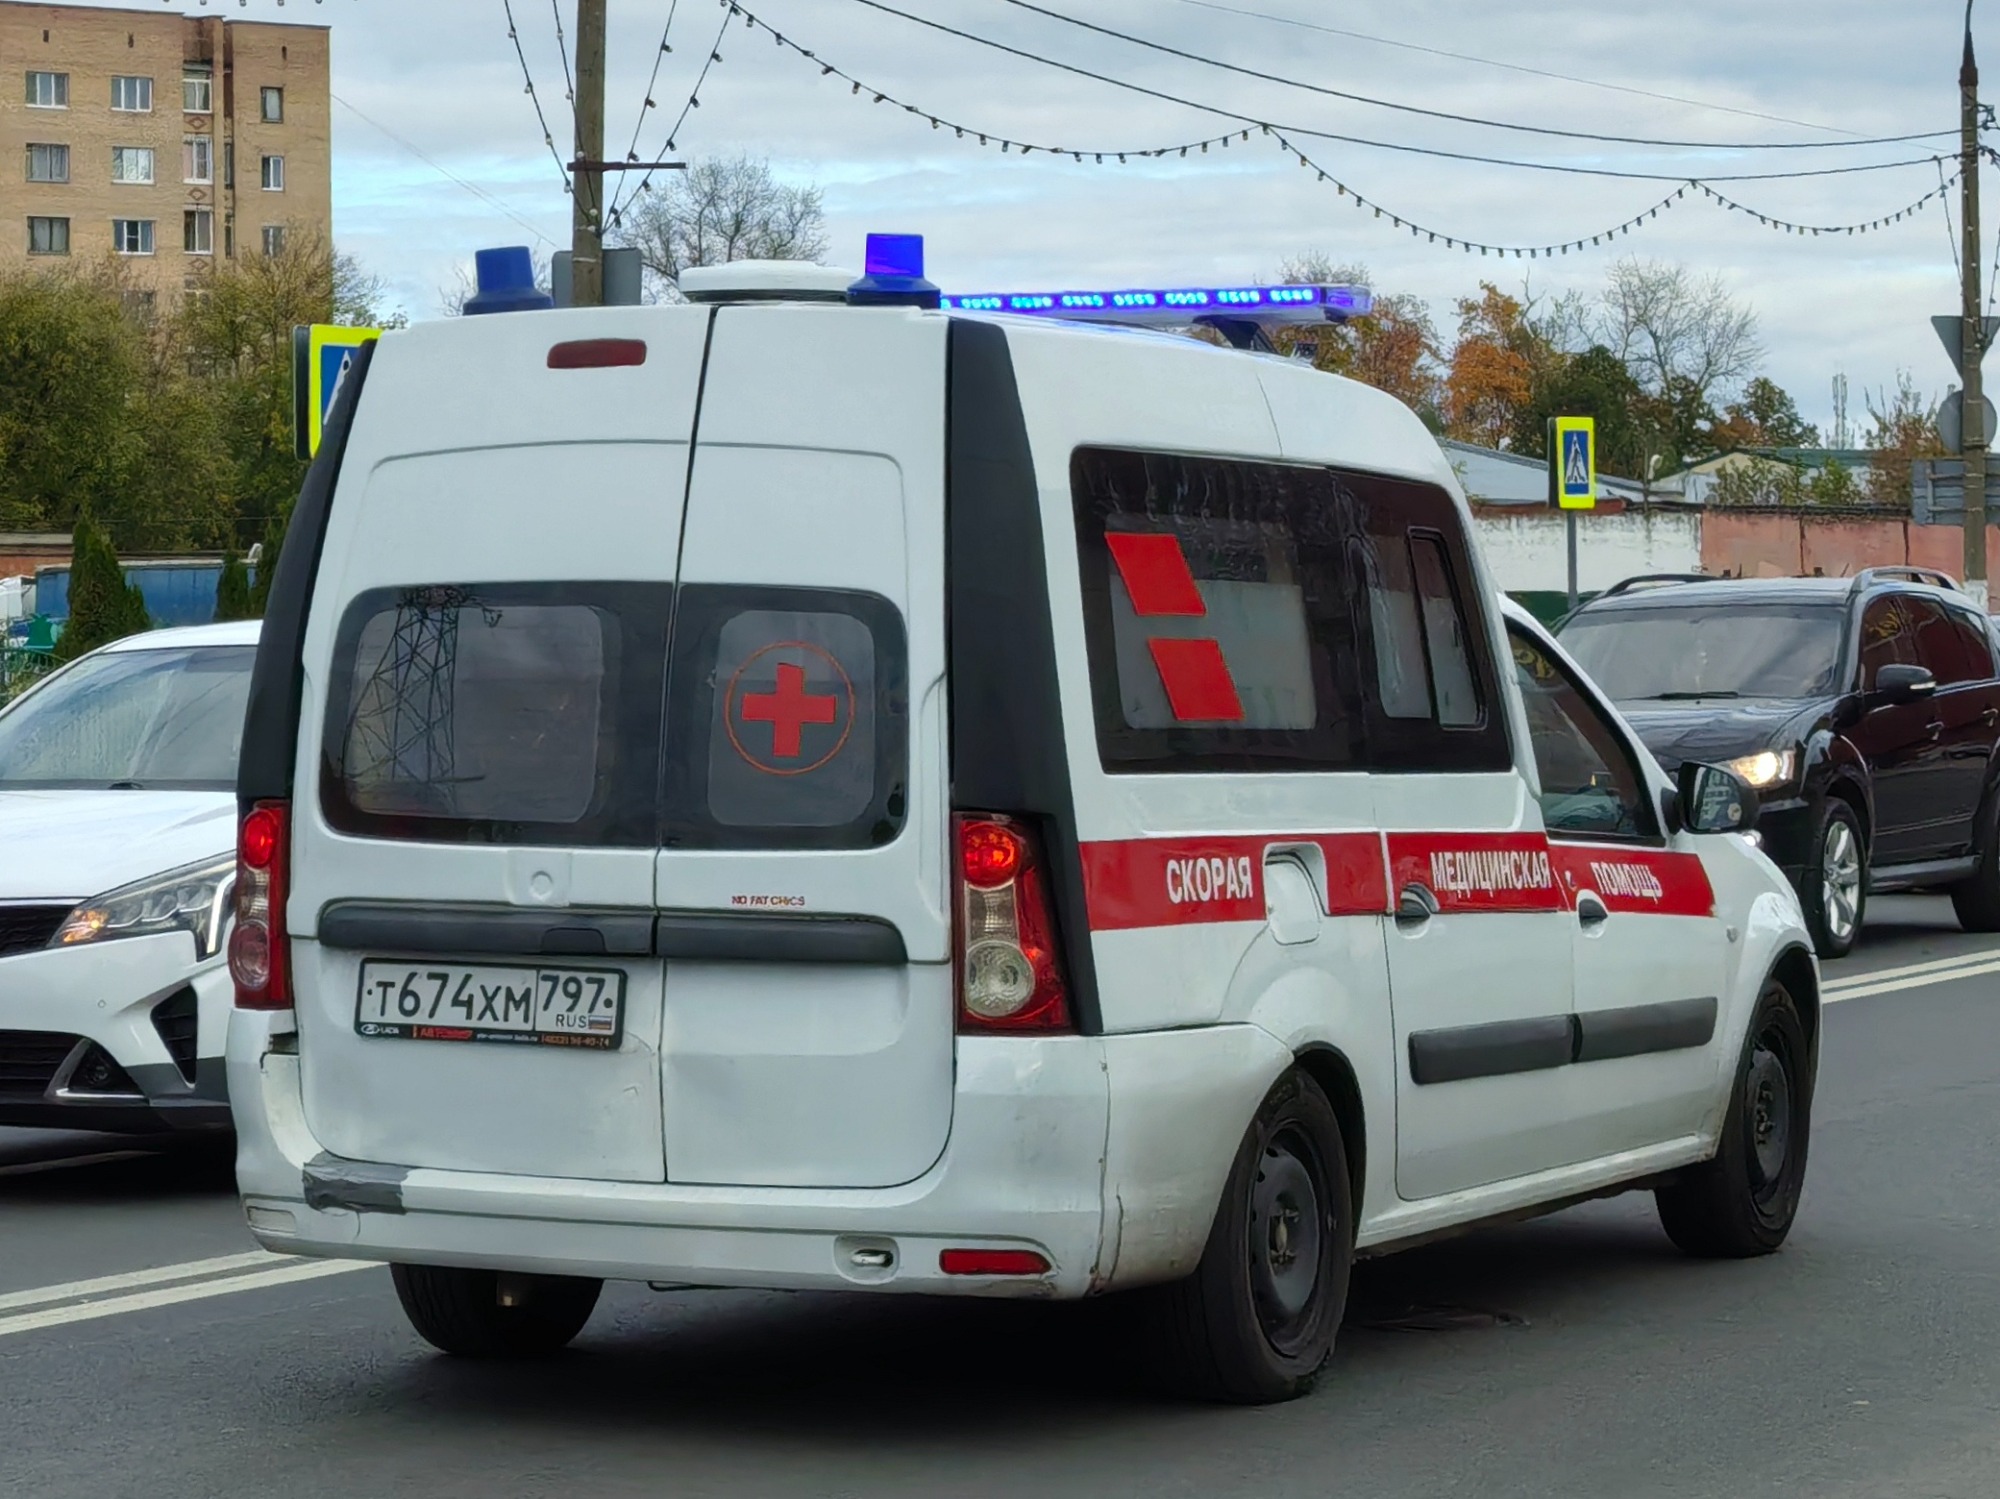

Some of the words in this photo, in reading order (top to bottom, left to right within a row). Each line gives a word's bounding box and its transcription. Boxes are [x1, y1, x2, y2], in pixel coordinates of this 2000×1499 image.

[1166, 856, 1254, 904] СКОРАЯ
[1429, 851, 1553, 898] МЕДИЦИНСКАЯ
[1590, 861, 1664, 905] ПОМОЩЬ
[540, 974, 606, 1014] 797
[555, 1014, 587, 1028] RUS
